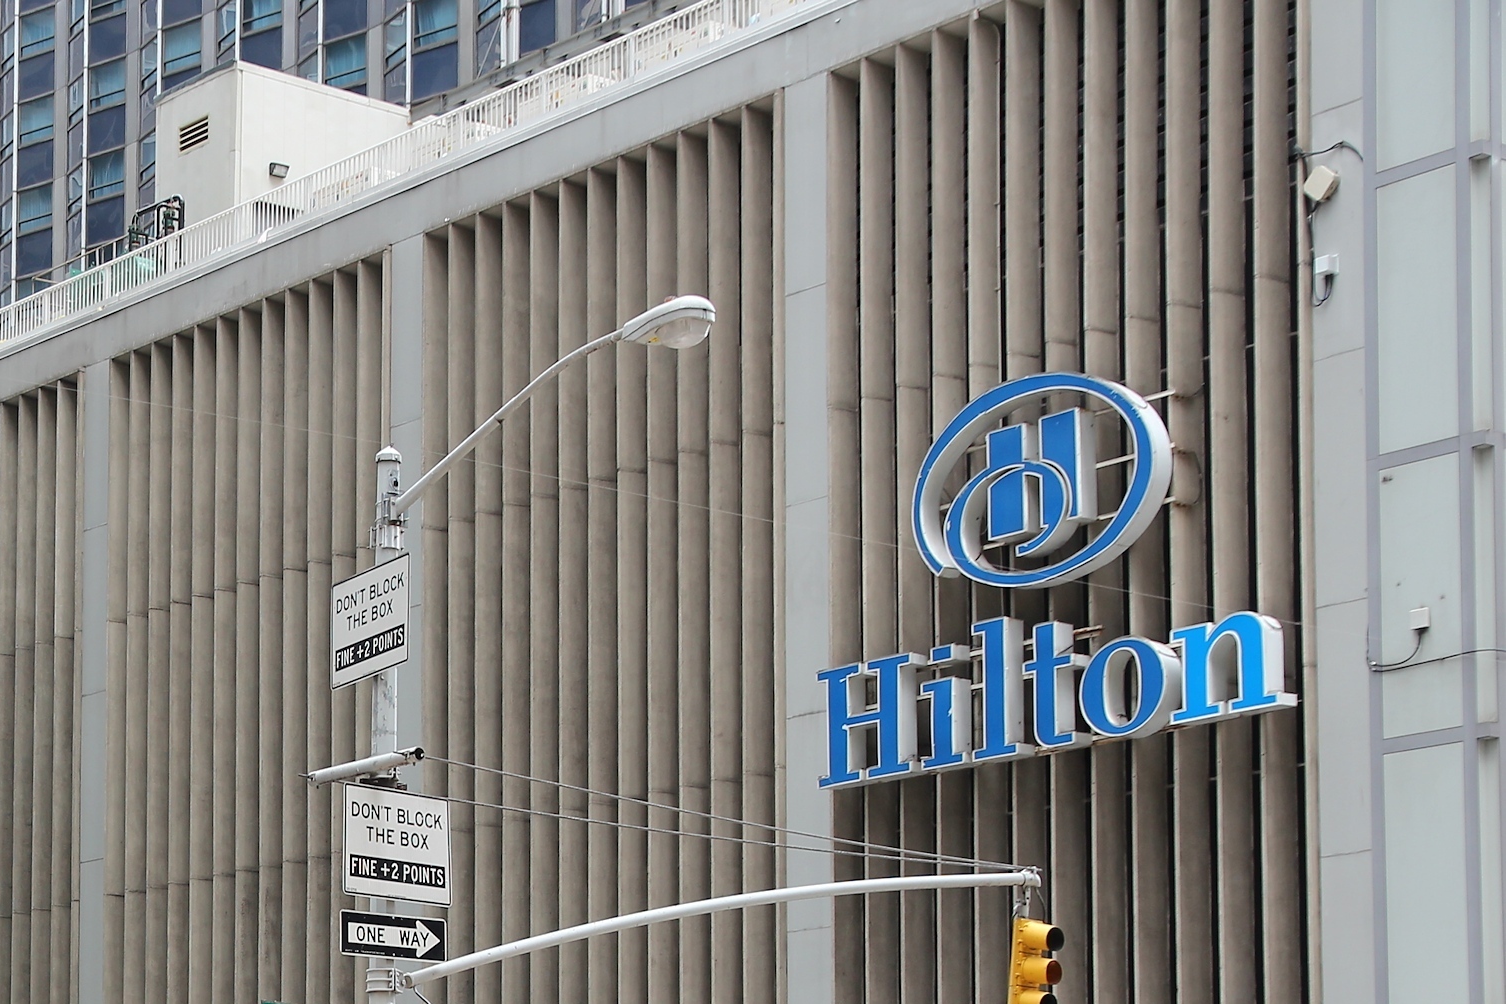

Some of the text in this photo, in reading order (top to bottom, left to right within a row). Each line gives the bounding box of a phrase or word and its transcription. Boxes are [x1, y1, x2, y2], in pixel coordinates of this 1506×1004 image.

[336, 572, 405, 614] DON'T BLOCK
[346, 599, 393, 631] THE BOX
[336, 627, 404, 669] FINE +2 POINTS
[817, 611, 1291, 789] Hilton
[351, 801, 442, 830] DON'T BLOCK
[366, 826, 429, 850] THE BOX
[352, 857, 444, 886] FINE +2 POINTS
[356, 925, 429, 948] ONE WAY
